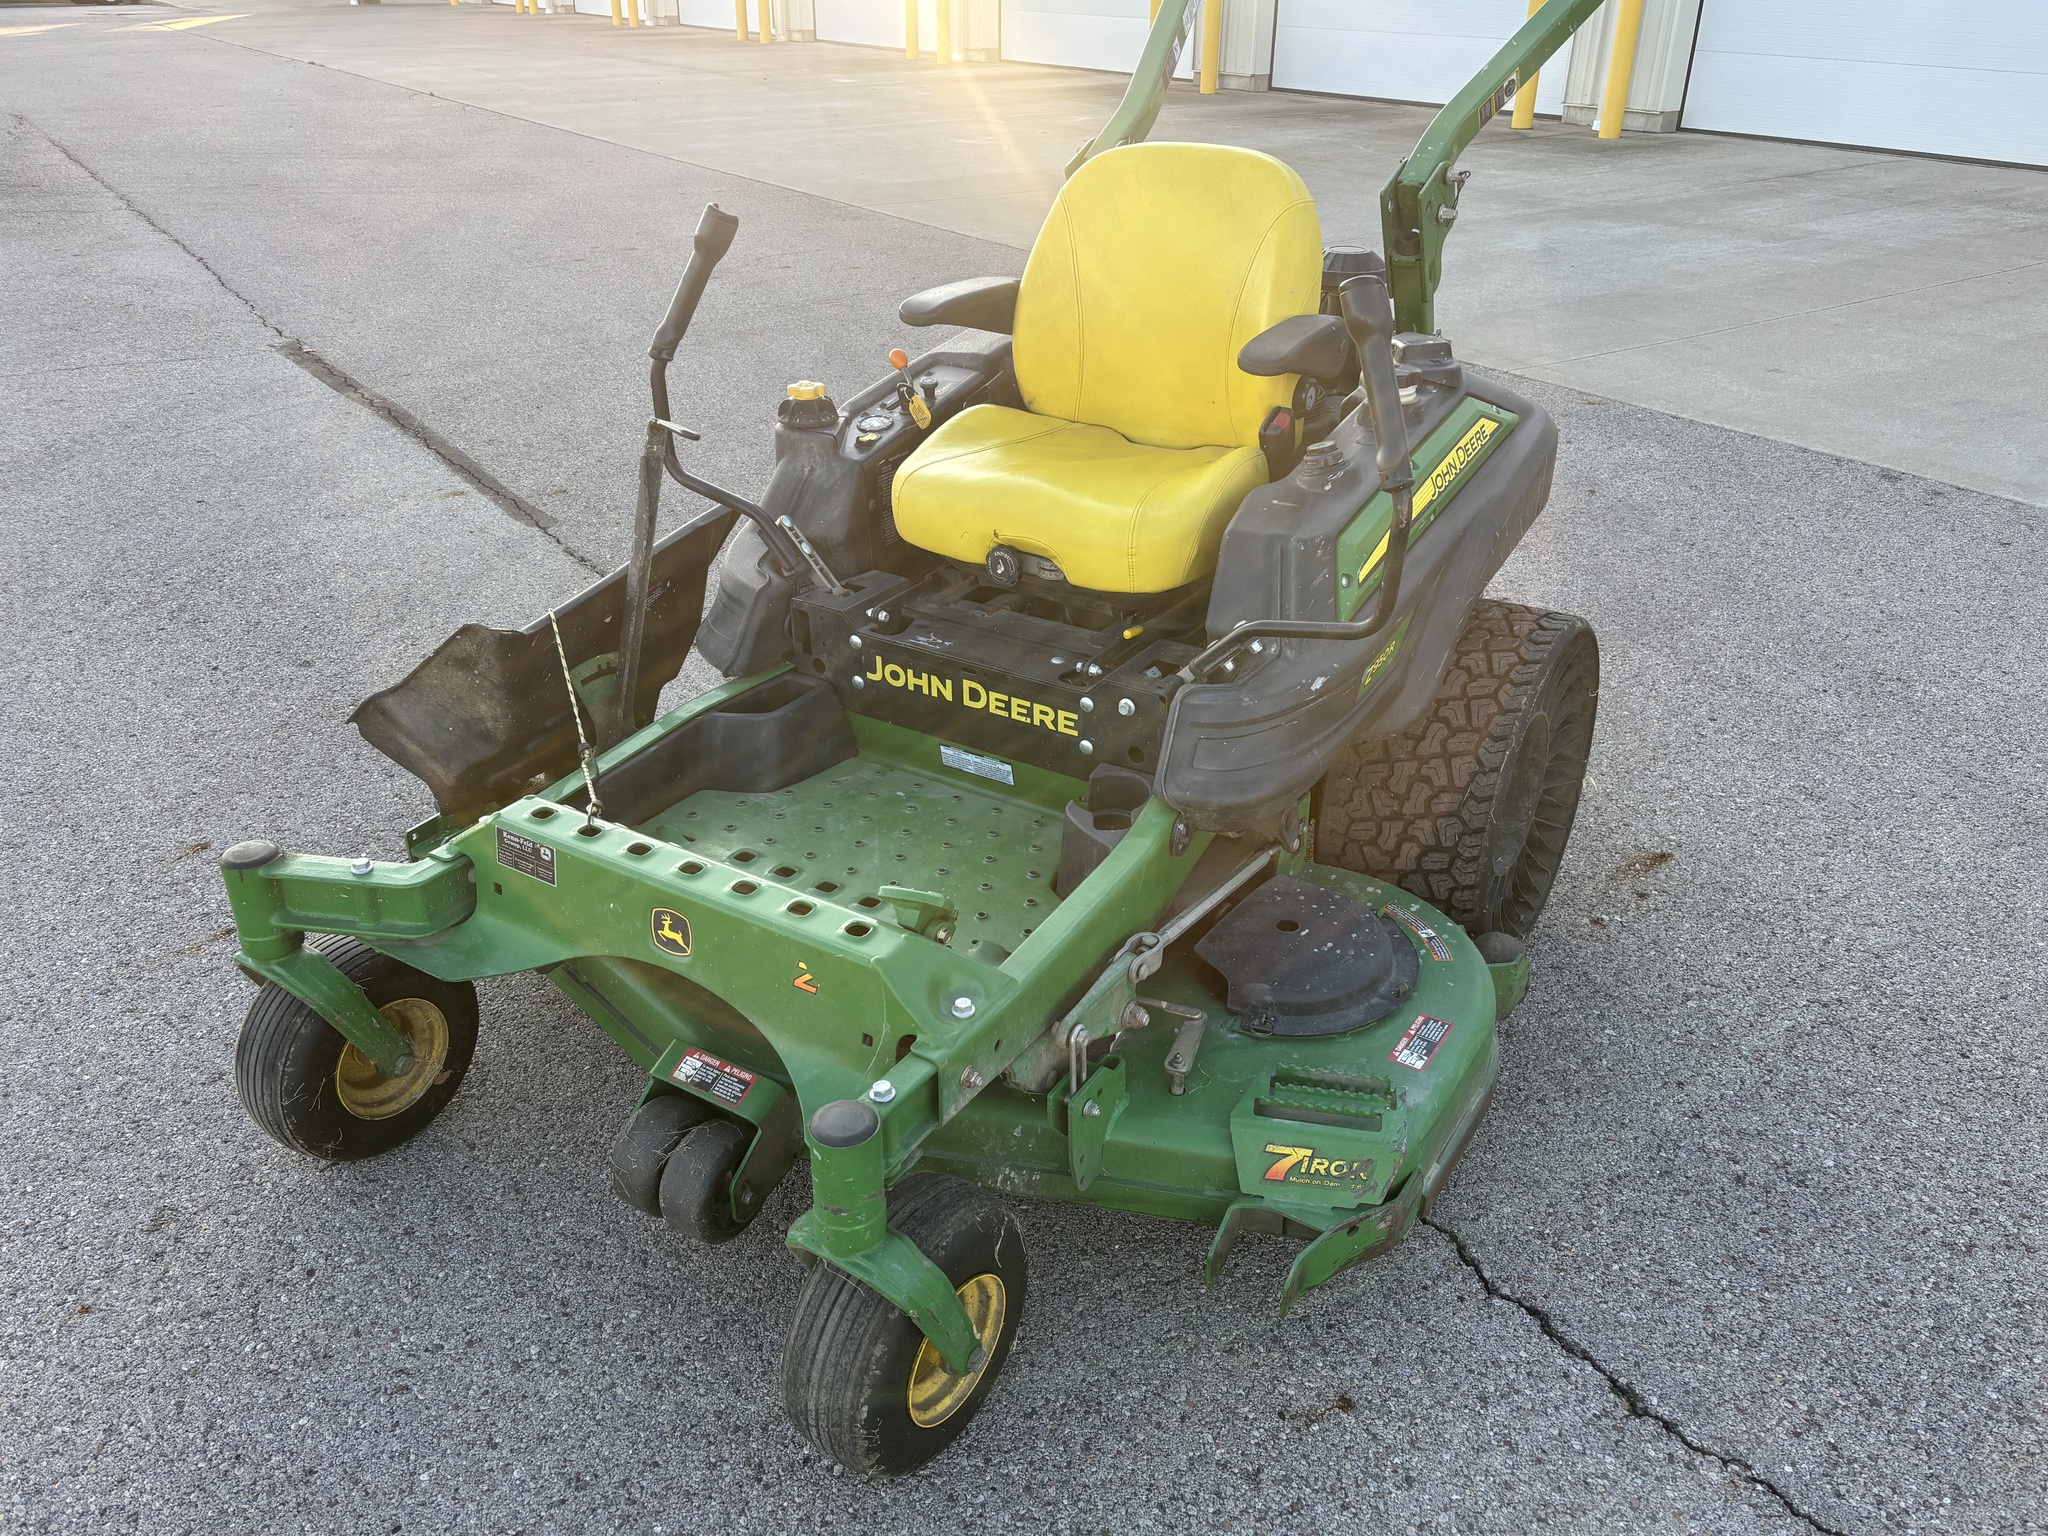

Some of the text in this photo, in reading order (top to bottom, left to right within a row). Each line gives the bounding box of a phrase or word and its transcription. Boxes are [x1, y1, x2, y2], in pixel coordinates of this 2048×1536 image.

[1431, 423, 1489, 498] JOHN DEERE
[866, 655, 1079, 737] JOHN DEERE
[1394, 1036, 1410, 1052] DANGER
[700, 1054, 720, 1067] DANGER
[730, 1067, 753, 1081] PELIGRO
